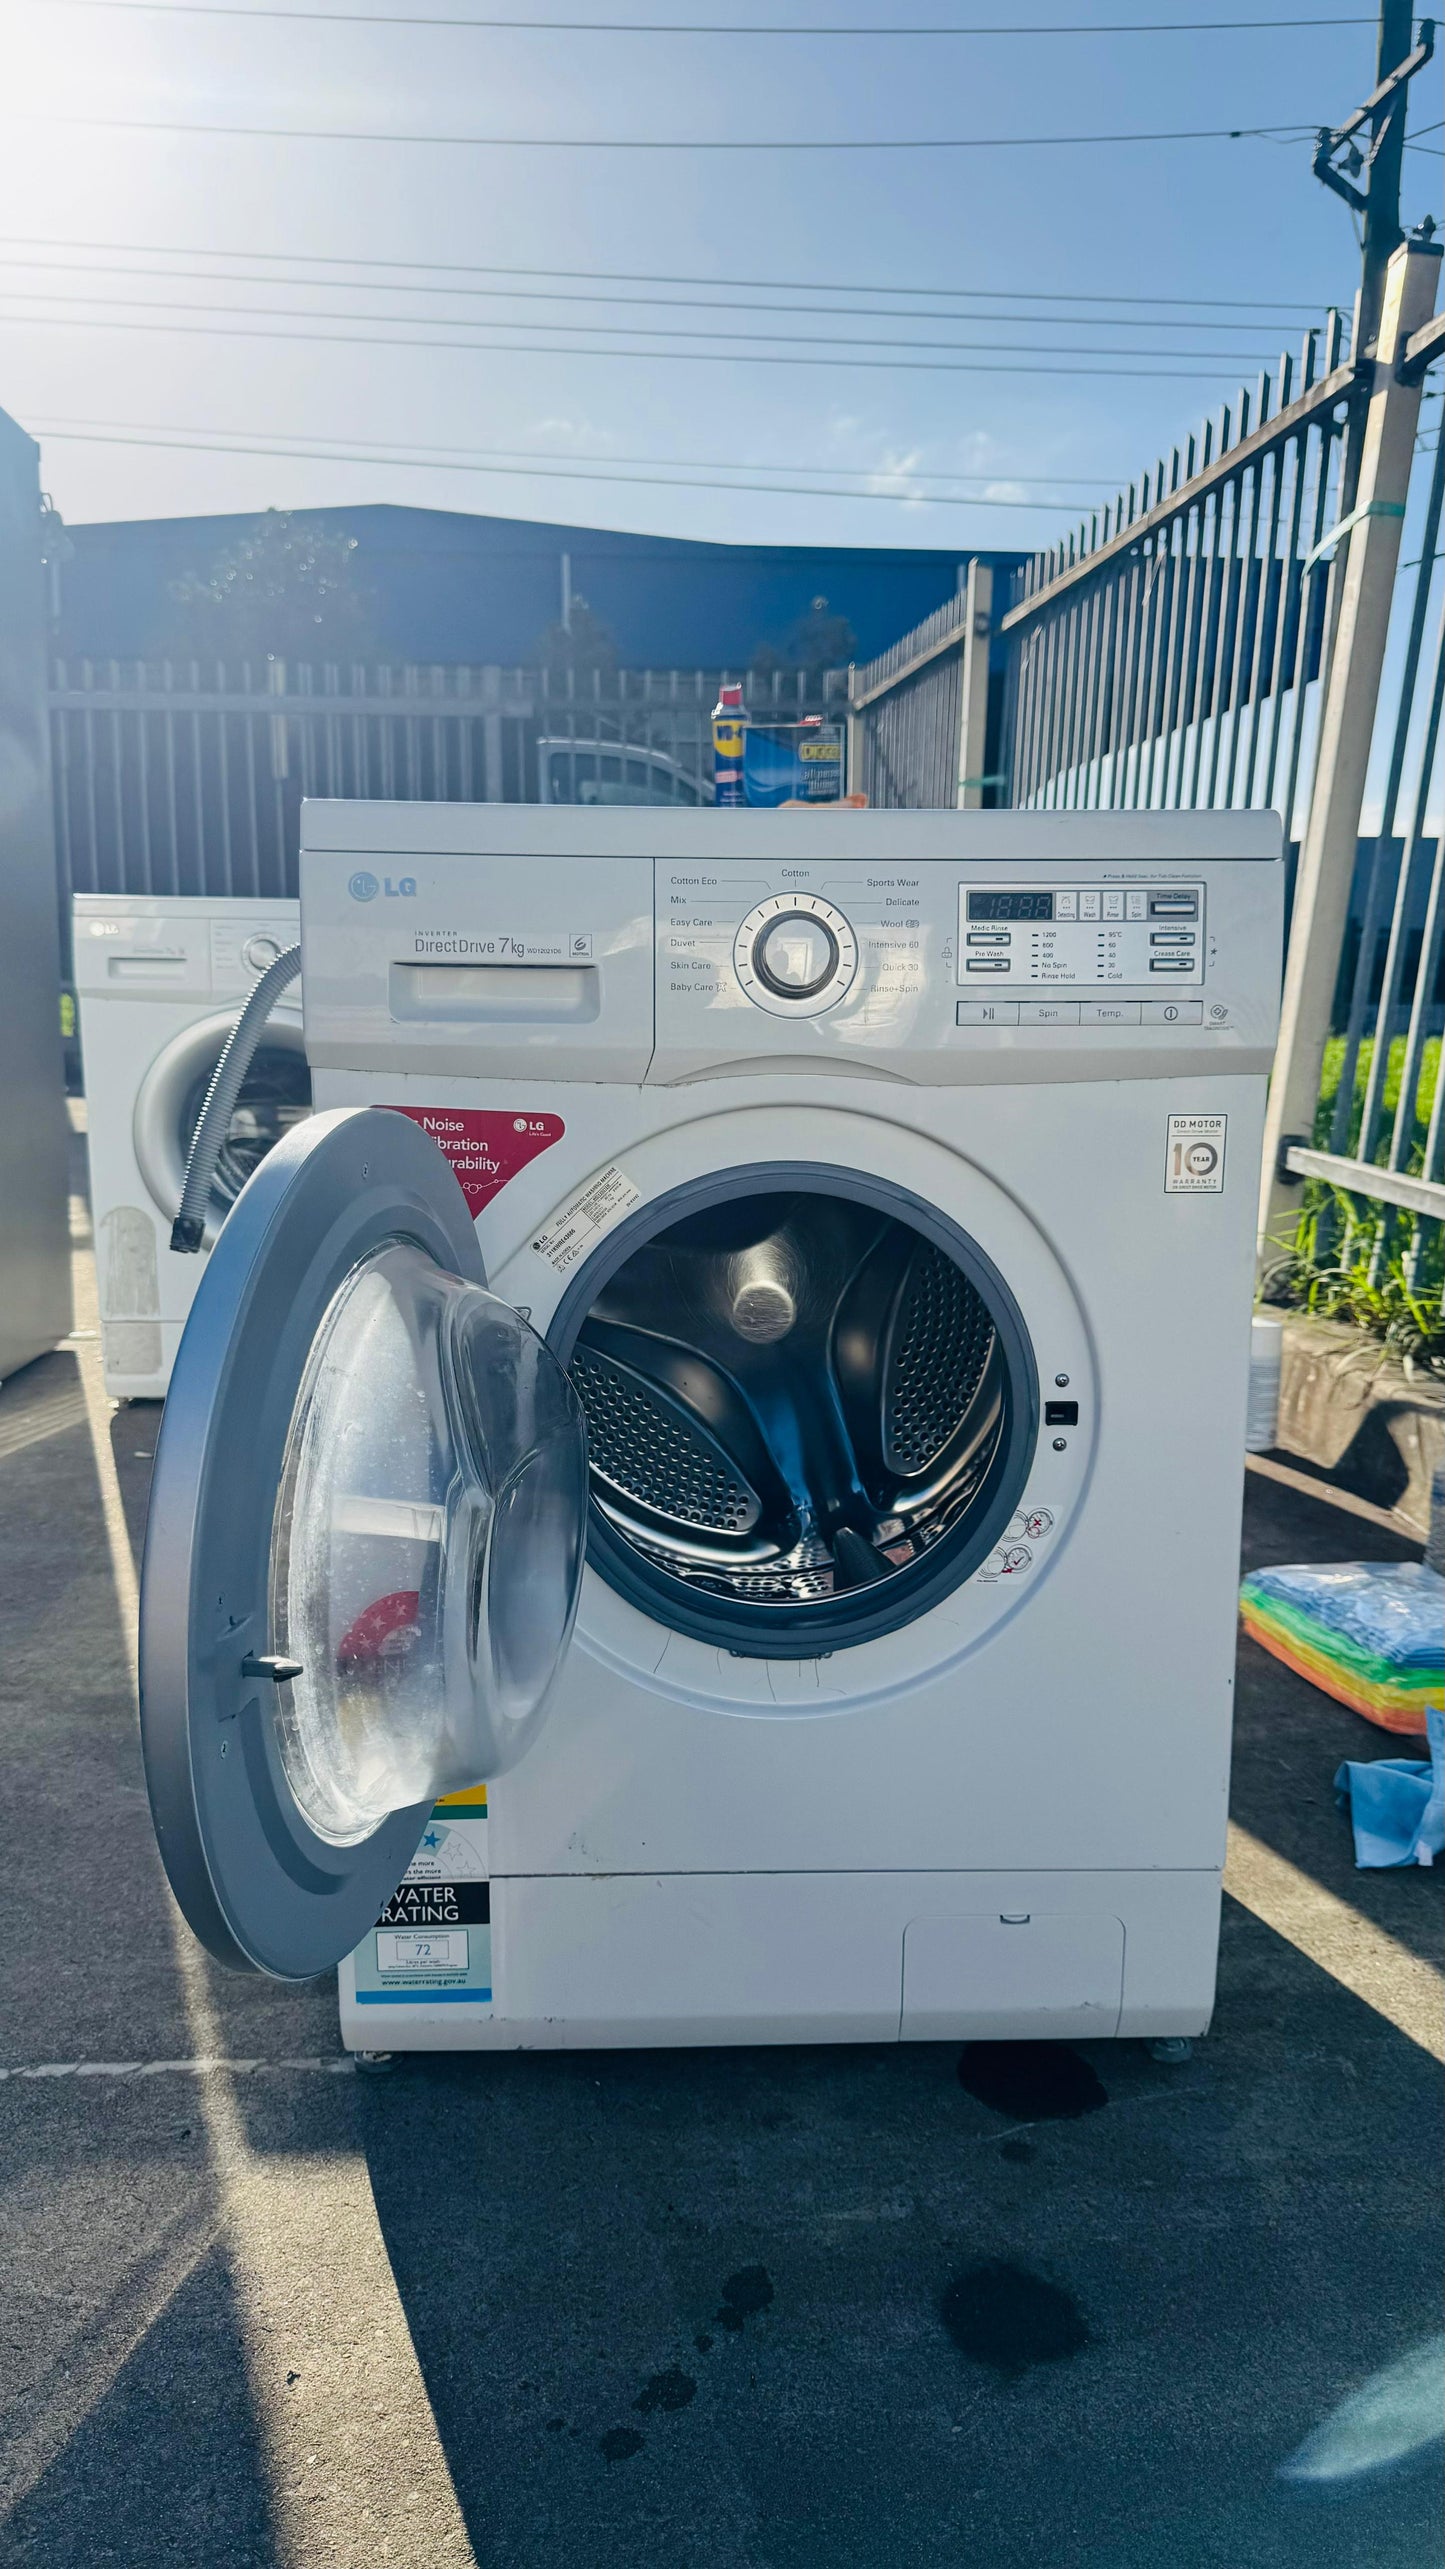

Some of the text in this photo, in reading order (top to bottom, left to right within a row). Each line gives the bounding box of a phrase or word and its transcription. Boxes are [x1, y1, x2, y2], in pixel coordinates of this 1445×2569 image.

[781, 869, 810, 878] Cotton
[670, 876, 718, 886] Cotton Eco
[866, 878, 920, 888] Sports Wear
[384, 877, 417, 897] LG
[670, 895, 687, 904] Mix
[886, 898, 920, 906] Delicate
[1131, 911, 1142, 919] Spin
[670, 918, 712, 929] Easy Care
[881, 920, 903, 928] Wool
[670, 938, 695, 947] Duvet
[868, 941, 919, 949] Intensive 60
[670, 961, 711, 970] Skin Care
[882, 963, 919, 972] Quick 30
[1053, 962, 1067, 970] Spin
[670, 982, 713, 992] Baby Care
[870, 984, 919, 994] Rinse+Spin
[1038, 1009, 1058, 1019] Spin
[1097, 1009, 1124, 1019] Temp.
[423, 1117, 465, 1131] Noise
[529, 1121, 545, 1131] LG
[1173, 1120, 1222, 1128] DD MOTOR
[432, 1136, 489, 1152] bration
[1173, 1142, 1218, 1177] 10
[448, 1156, 501, 1175] rability
[539, 1235, 548, 1243] LG
[381, 1905, 459, 1922] RATING
[413, 1932, 450, 1940] Consumption
[415, 1944, 431, 1956] 72
